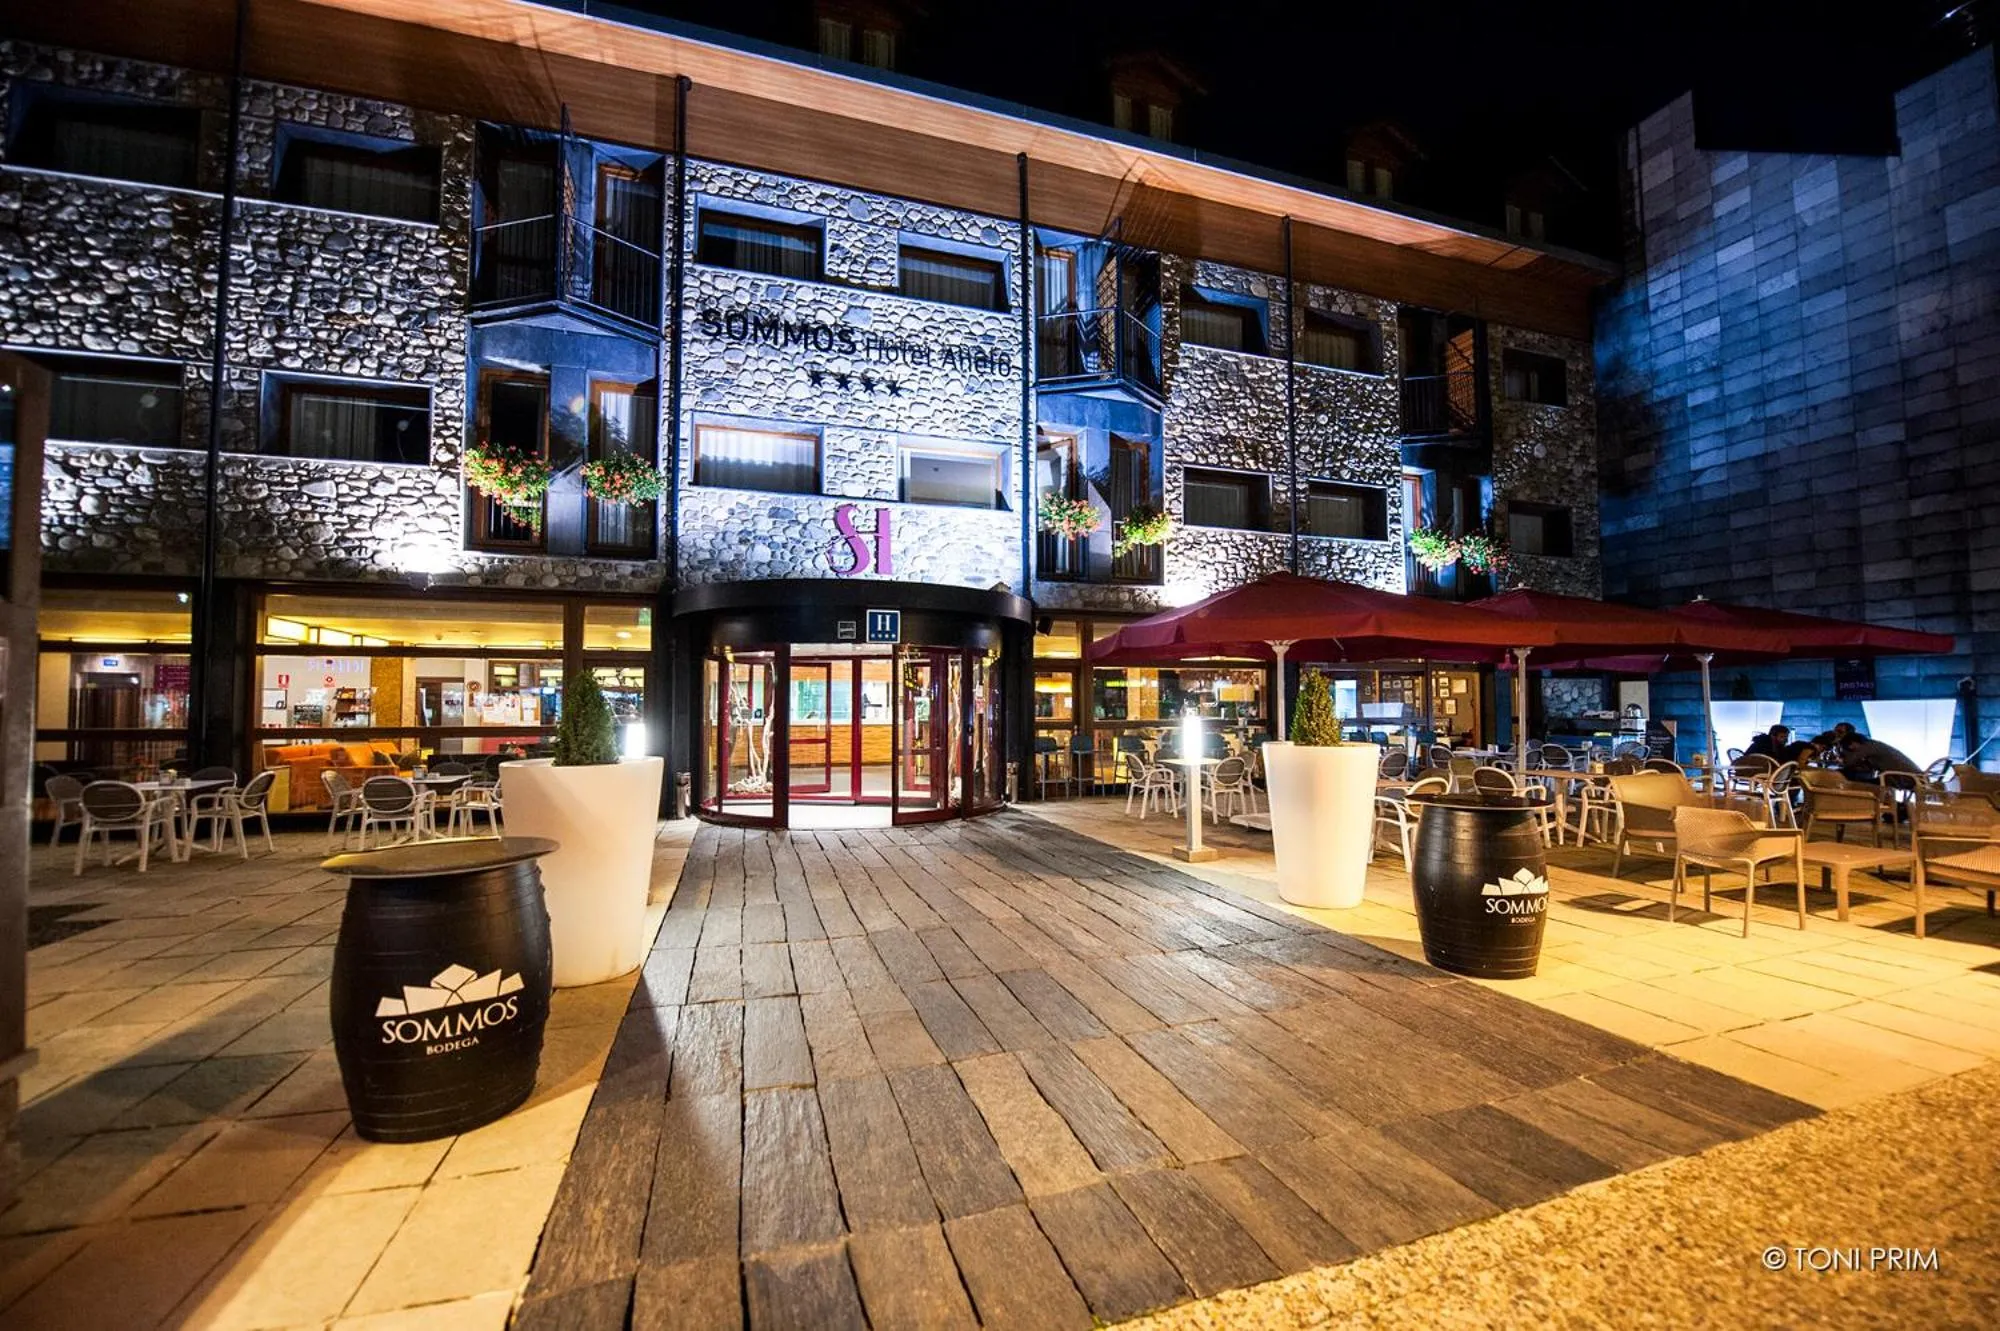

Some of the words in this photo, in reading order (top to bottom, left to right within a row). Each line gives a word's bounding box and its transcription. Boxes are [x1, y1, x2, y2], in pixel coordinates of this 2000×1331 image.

[701, 309, 857, 355] SOMMOS
[865, 336, 932, 368] Hotel
[942, 344, 1012, 377] Aneto
[877, 614, 891, 631] H
[1485, 896, 1547, 915] SOMMO
[381, 995, 518, 1044] SOMMOS
[426, 1036, 479, 1056] BODEGA
